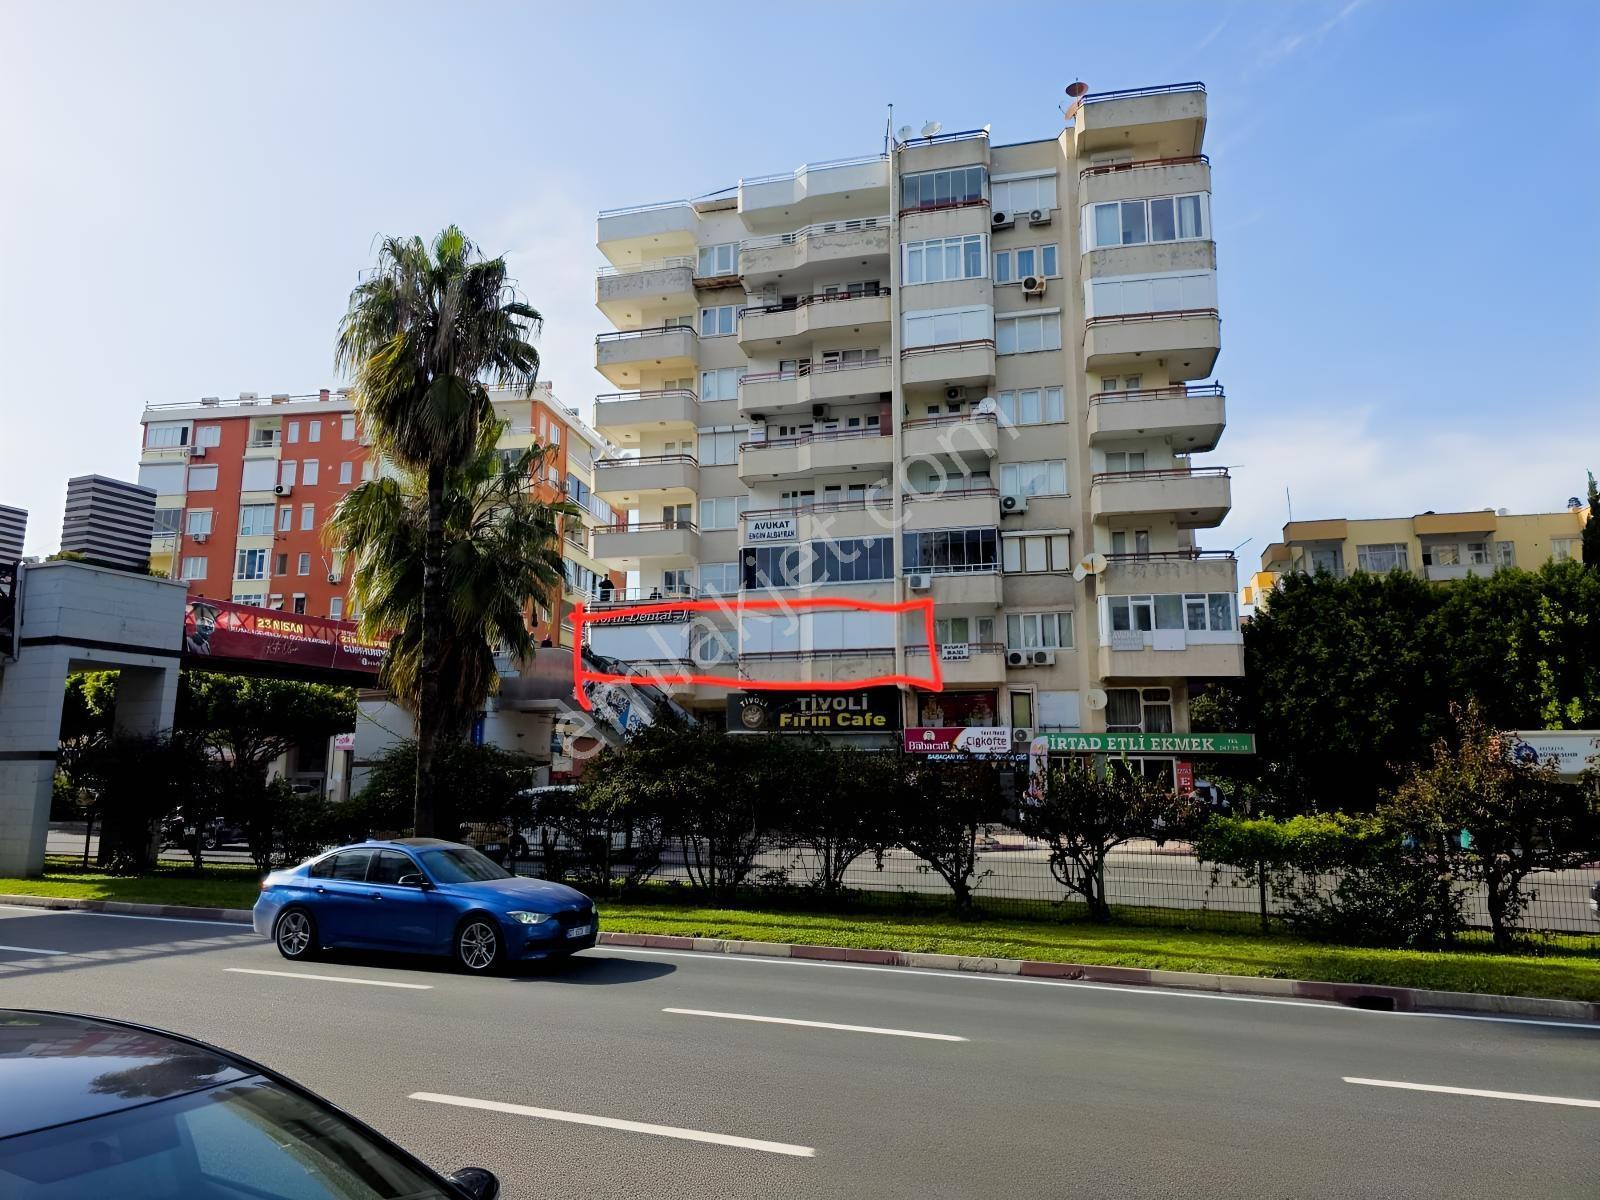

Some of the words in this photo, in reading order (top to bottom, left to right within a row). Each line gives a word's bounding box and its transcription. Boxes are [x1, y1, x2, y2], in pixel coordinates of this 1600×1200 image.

[754, 521, 790, 530] AVUKAT
[257, 618, 271, 629] 23
[836, 712, 887, 726] Cafe
[1107, 735, 1145, 750] ETLİ
[1150, 737, 1215, 751] EKMEK
